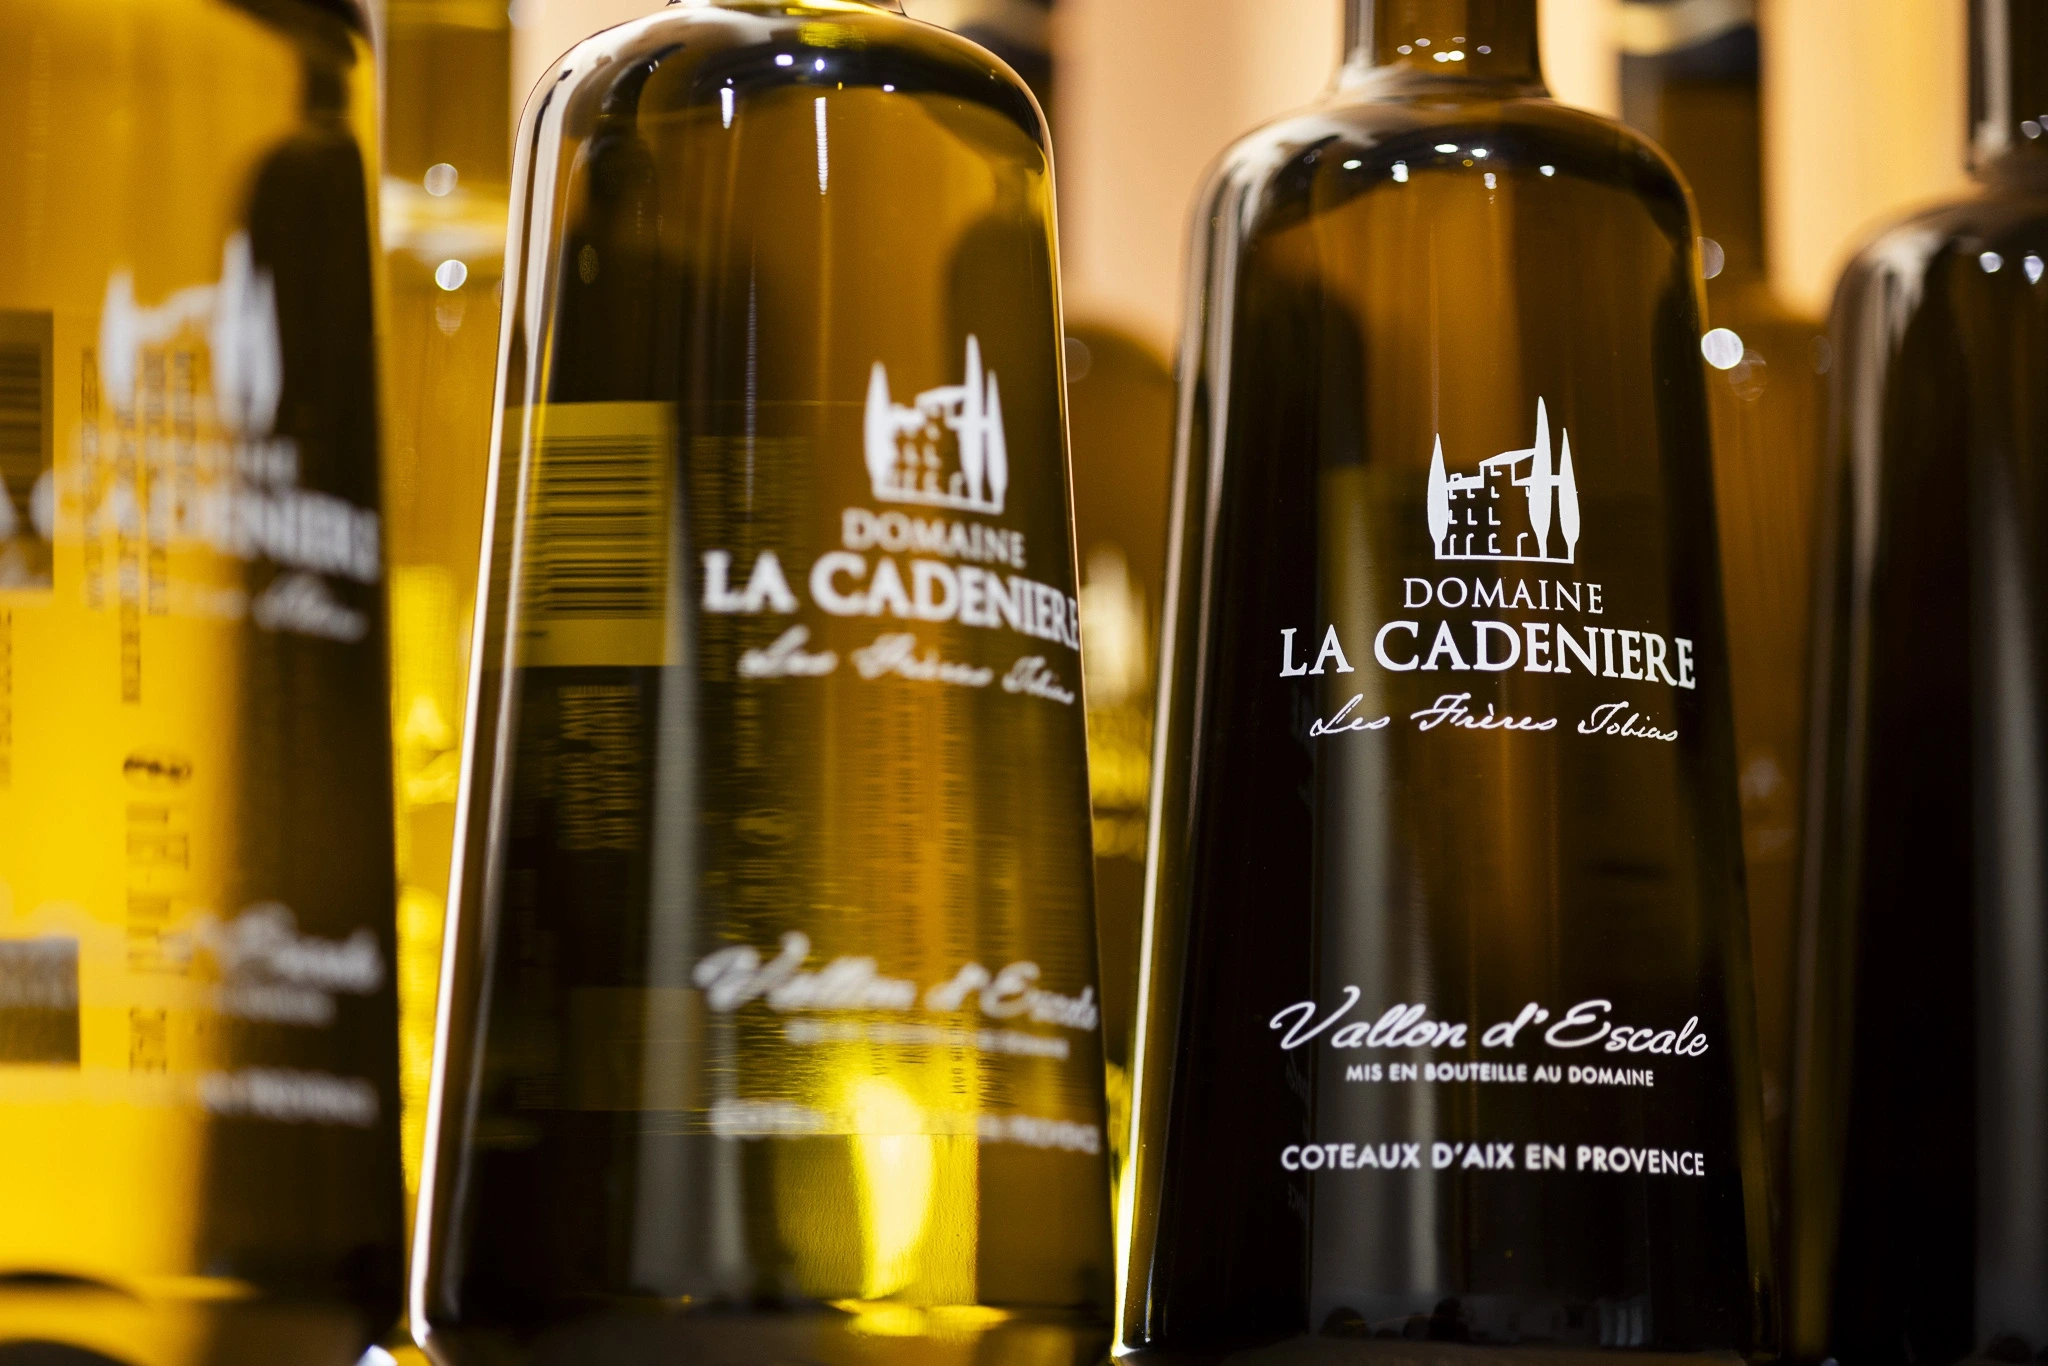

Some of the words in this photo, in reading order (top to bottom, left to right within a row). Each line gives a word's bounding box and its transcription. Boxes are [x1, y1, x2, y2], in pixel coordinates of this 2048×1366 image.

[841, 507, 1027, 570] DOMAINE
[702, 549, 799, 614] LA
[809, 550, 1081, 652] CADENIERE
[1403, 576, 1604, 614] DOMAINE
[1280, 624, 1354, 678] LA
[1373, 620, 1697, 690] CADENIERE
[1310, 693, 1391, 738] Les
[1410, 692, 1557, 732] Frères
[1577, 700, 1679, 743] Tobias
[1269, 984, 1467, 1051] Vallon
[1481, 999, 1709, 1057] d'Escale
[1346, 1063, 1383, 1082] MIS
[1389, 1063, 1418, 1082] EN
[1425, 1062, 1528, 1083] BOUTEILLE
[1533, 1064, 1562, 1083] AU
[1568, 1065, 1655, 1087] DOMAINE
[1280, 1142, 1421, 1171] COTEAUX
[1431, 1142, 1515, 1171] D'AIX
[1525, 1144, 1566, 1171] EN
[1576, 1145, 1706, 1177] PROVENCE
